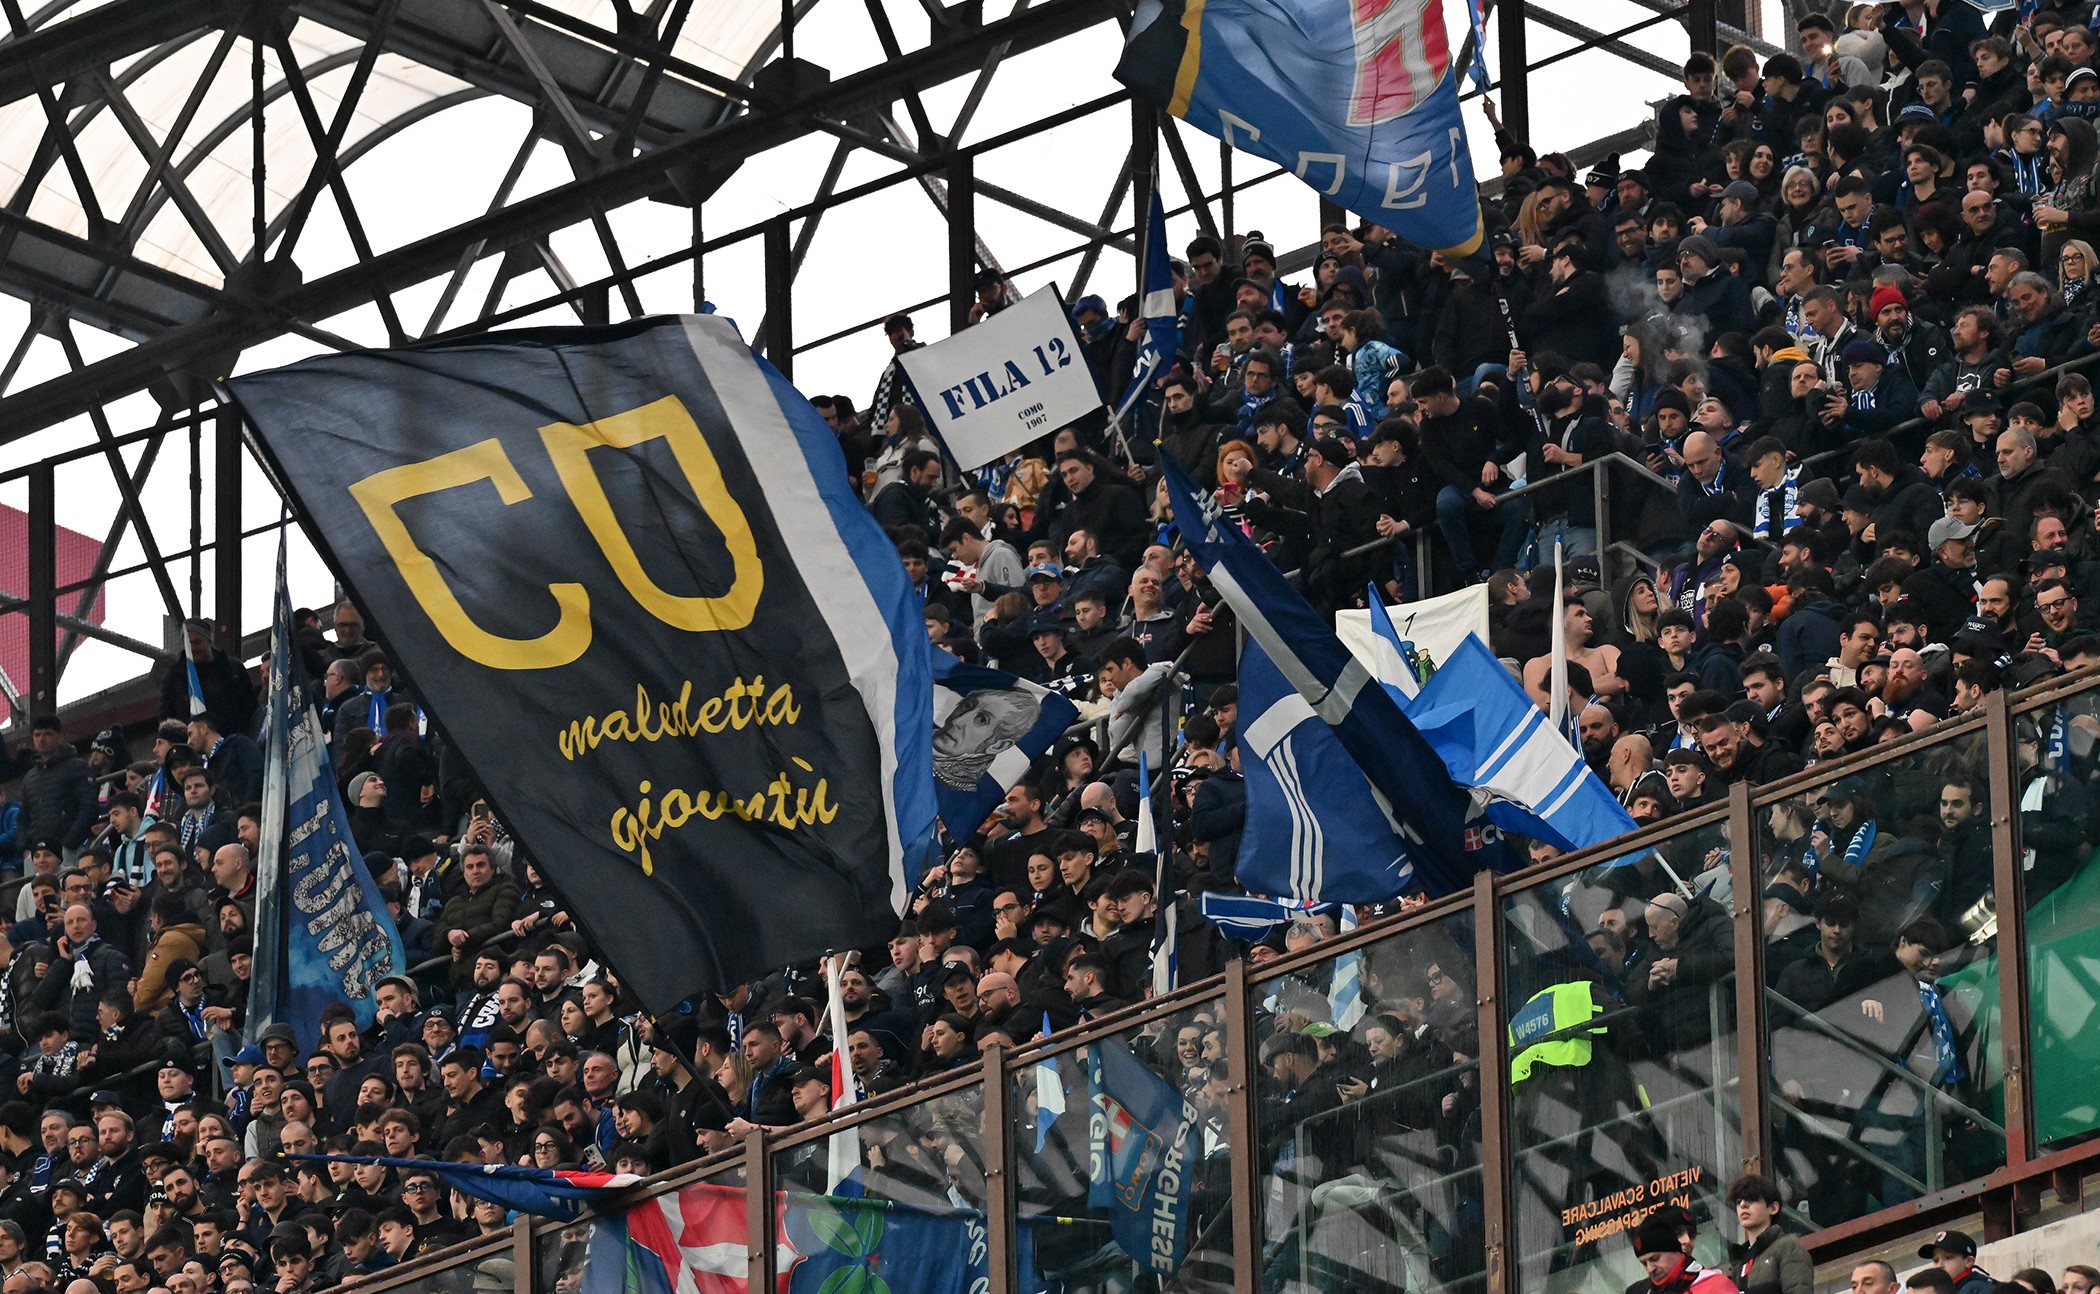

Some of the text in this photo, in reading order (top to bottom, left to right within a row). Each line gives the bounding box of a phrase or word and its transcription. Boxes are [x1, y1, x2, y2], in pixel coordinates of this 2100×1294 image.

[939, 337, 1071, 420] FILA 12
[1018, 402, 1044, 420] COMO
[1025, 414, 1048, 430] 1907
[559, 675, 801, 761] maledetta
[1515, 1013, 1549, 1040] W4576
